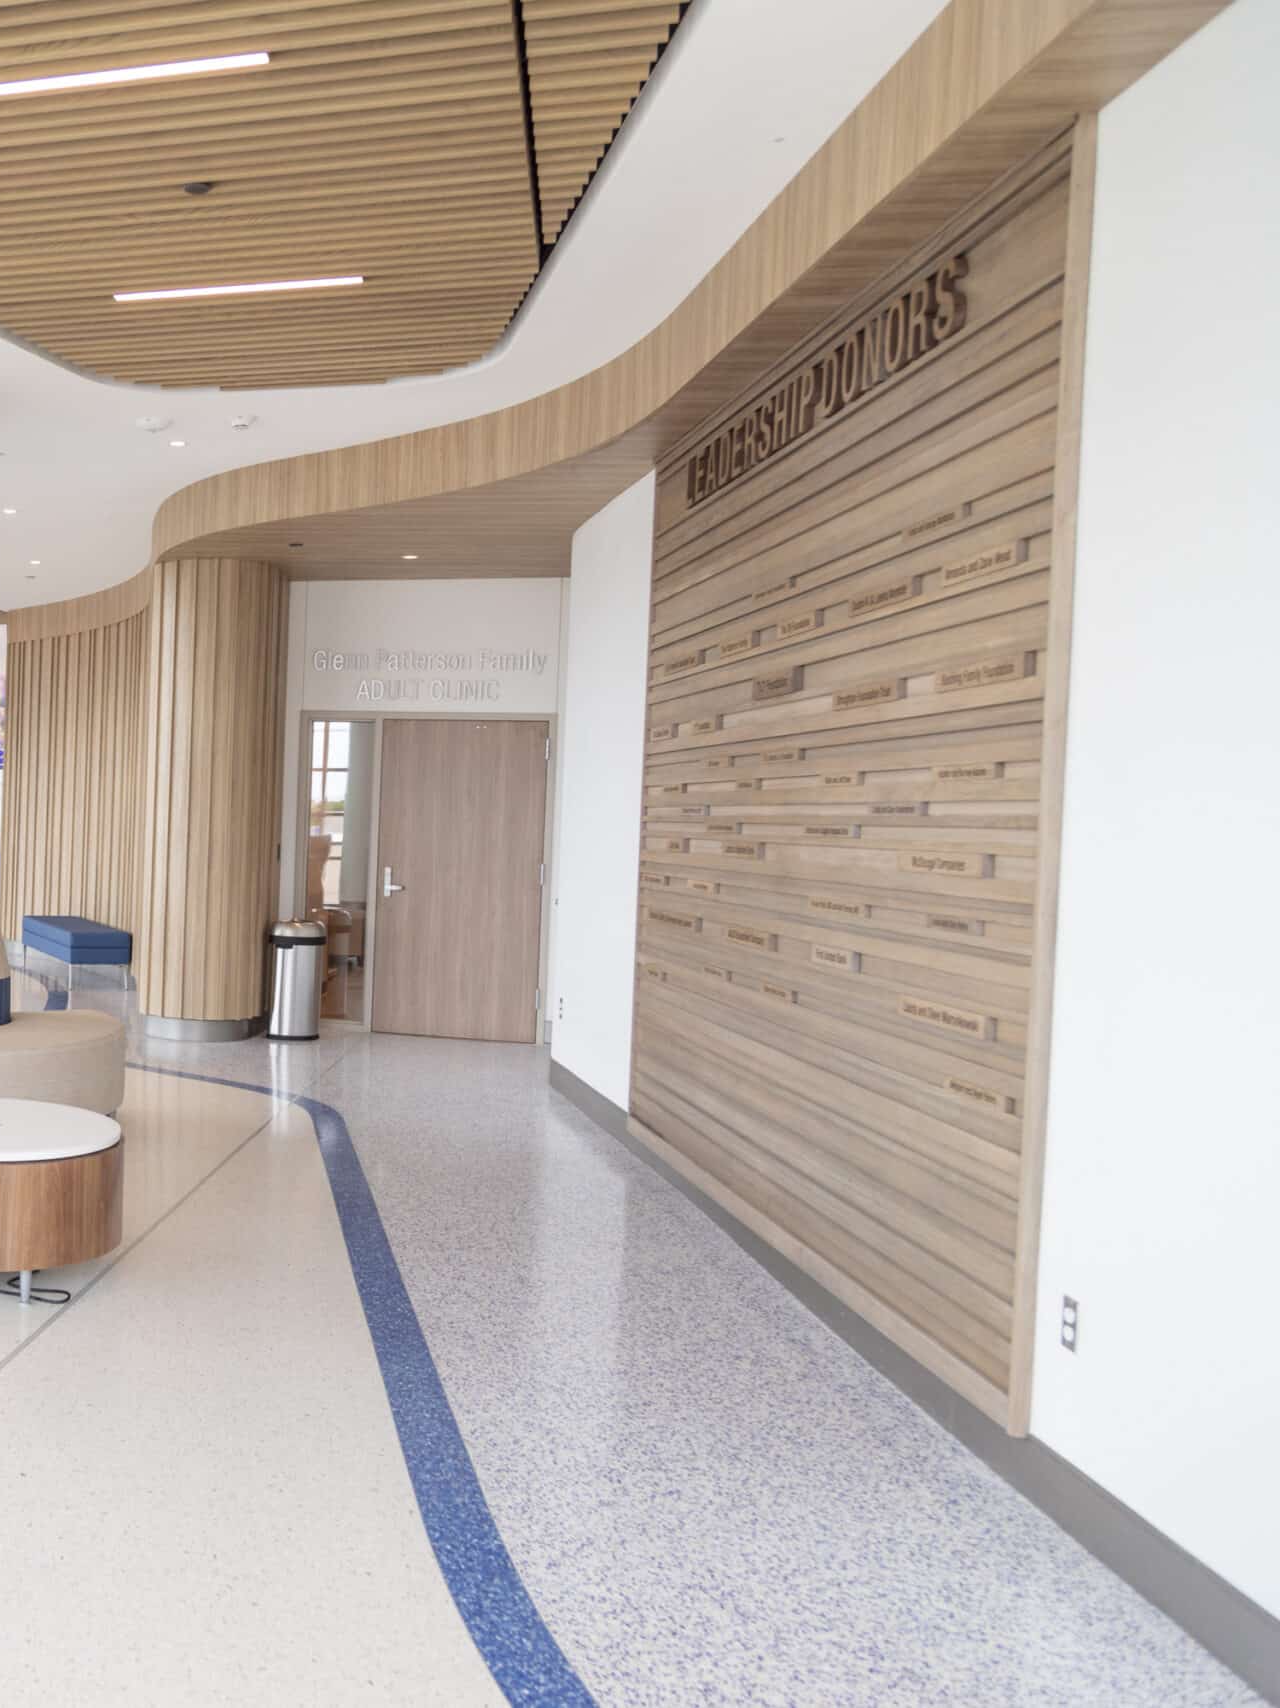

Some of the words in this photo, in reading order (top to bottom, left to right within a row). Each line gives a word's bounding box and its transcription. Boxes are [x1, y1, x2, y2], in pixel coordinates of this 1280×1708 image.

[686, 368, 817, 507] LEADERSHIP
[820, 253, 969, 418] DONORS
[313, 648, 369, 671] Glenn
[376, 648, 472, 671] Patterson
[479, 648, 548, 676] Family
[355, 679, 425, 702] ADULT
[430, 679, 503, 702] CLINIC
